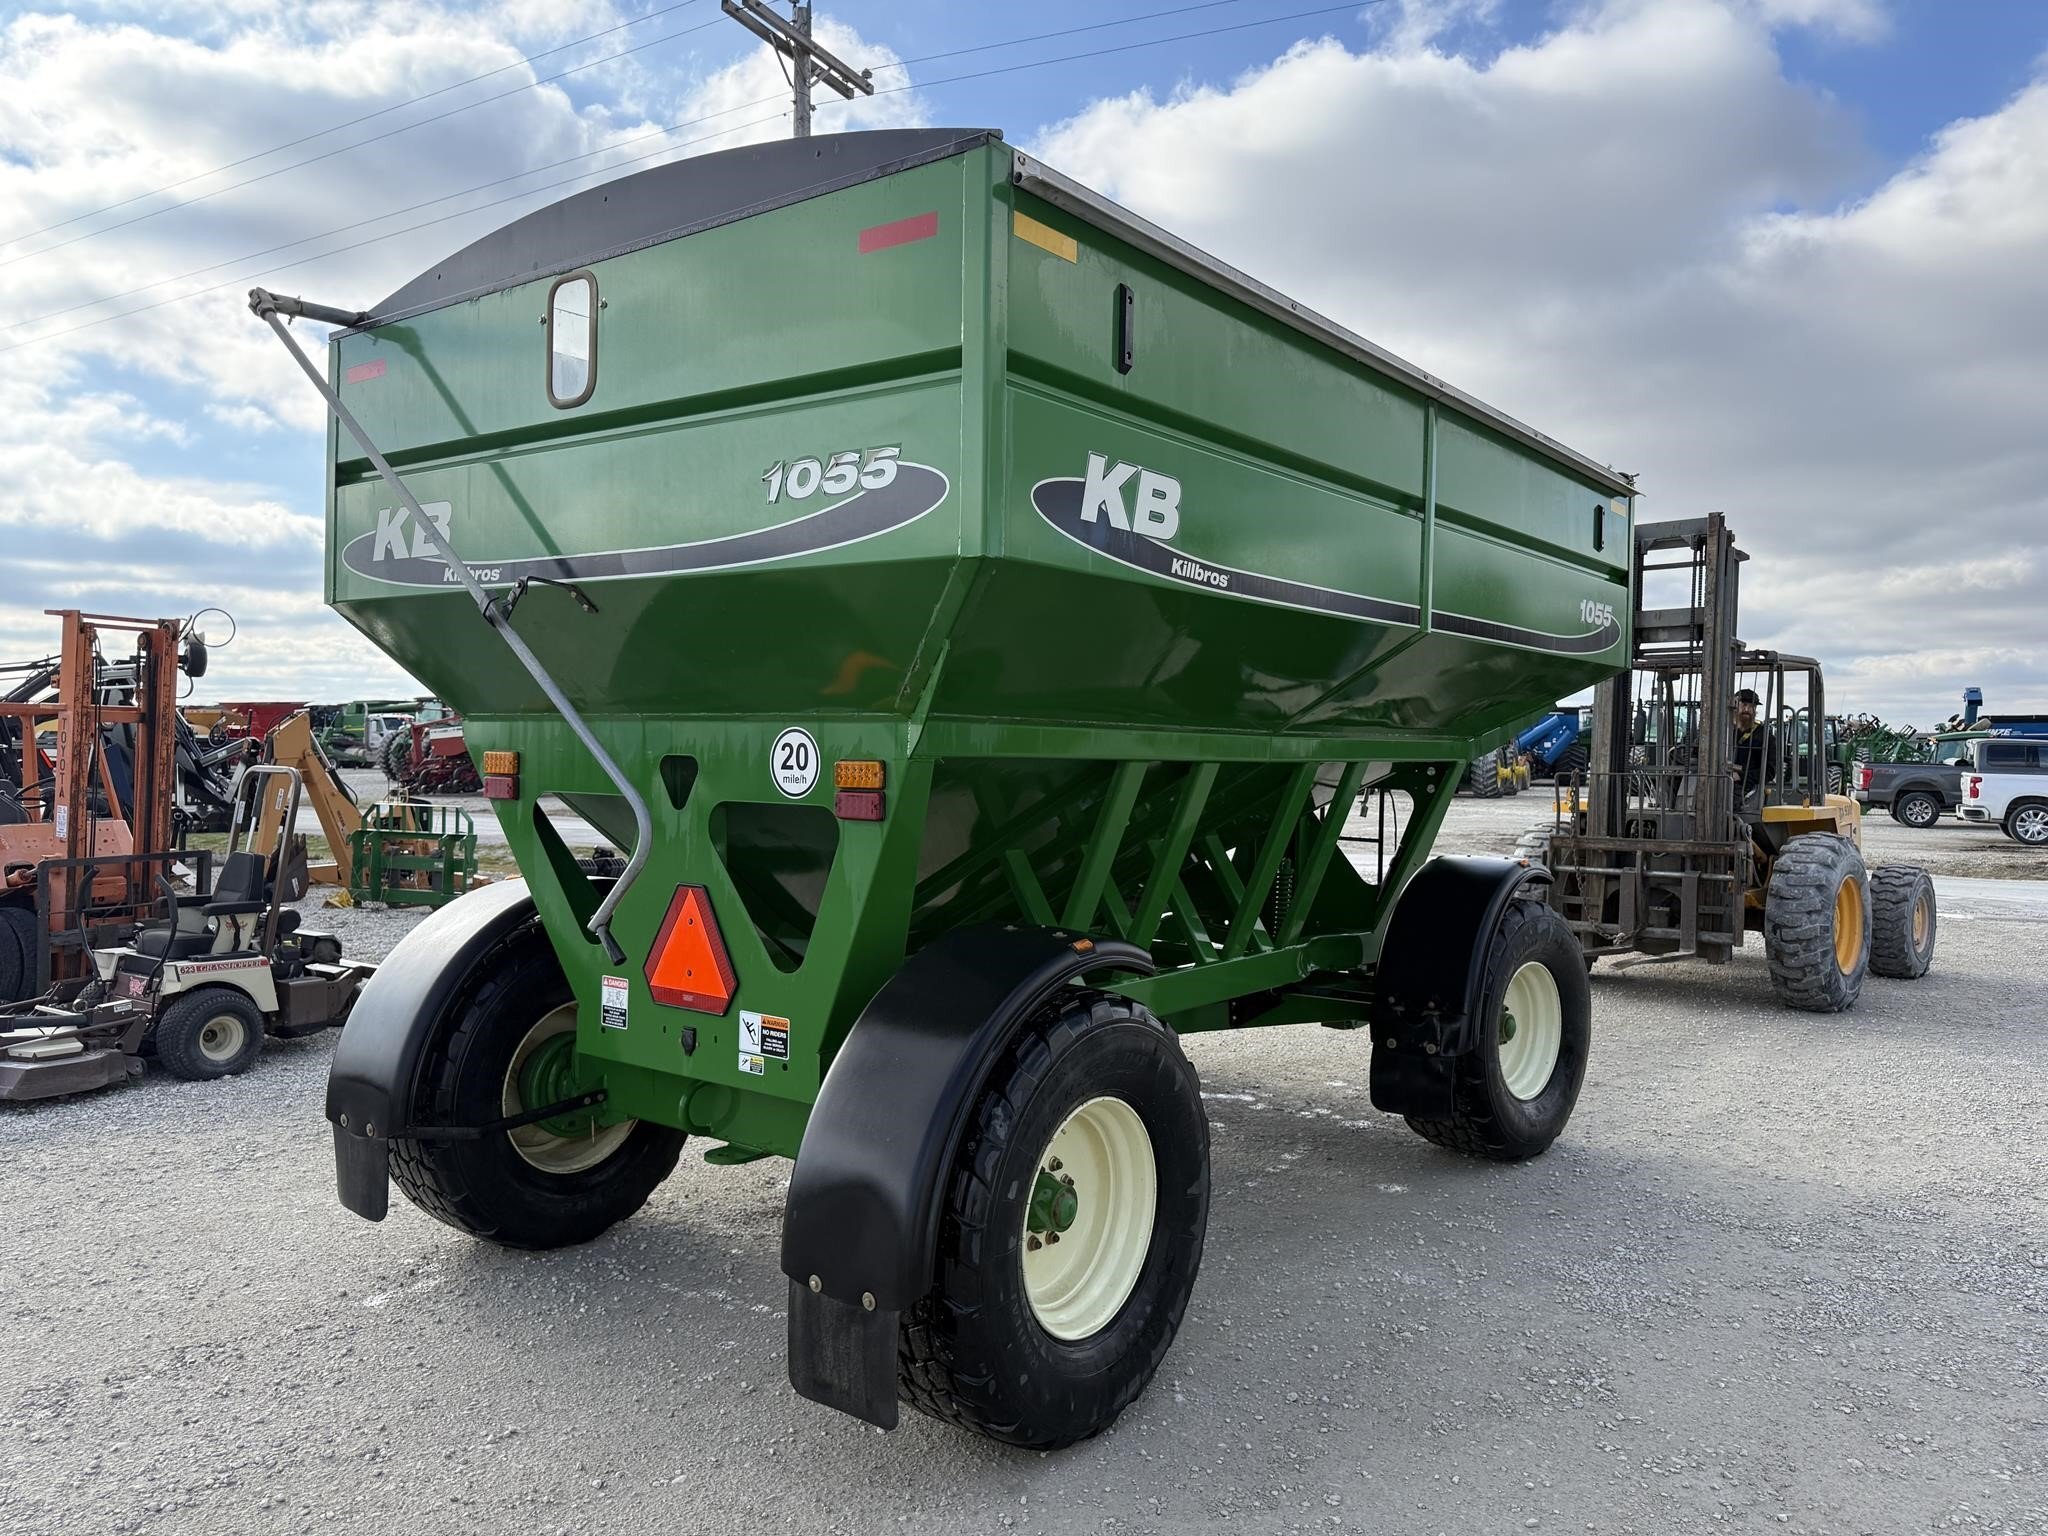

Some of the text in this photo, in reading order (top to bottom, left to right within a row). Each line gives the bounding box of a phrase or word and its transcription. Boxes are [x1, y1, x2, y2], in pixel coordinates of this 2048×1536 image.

[761, 446, 901, 504] 1055
[1080, 451, 1181, 541] KB
[373, 501, 452, 561] KB
[443, 566, 500, 581] Kiros
[1170, 558, 1229, 588] Killbros
[1580, 599, 1612, 627] 1055
[59, 717, 67, 798] TOYOTA
[780, 742, 809, 771] 20
[782, 774, 807, 784] mile/h
[180, 960, 260, 974] 623 GRASSHOPPER
[770, 1030, 786, 1038] RIDERS
